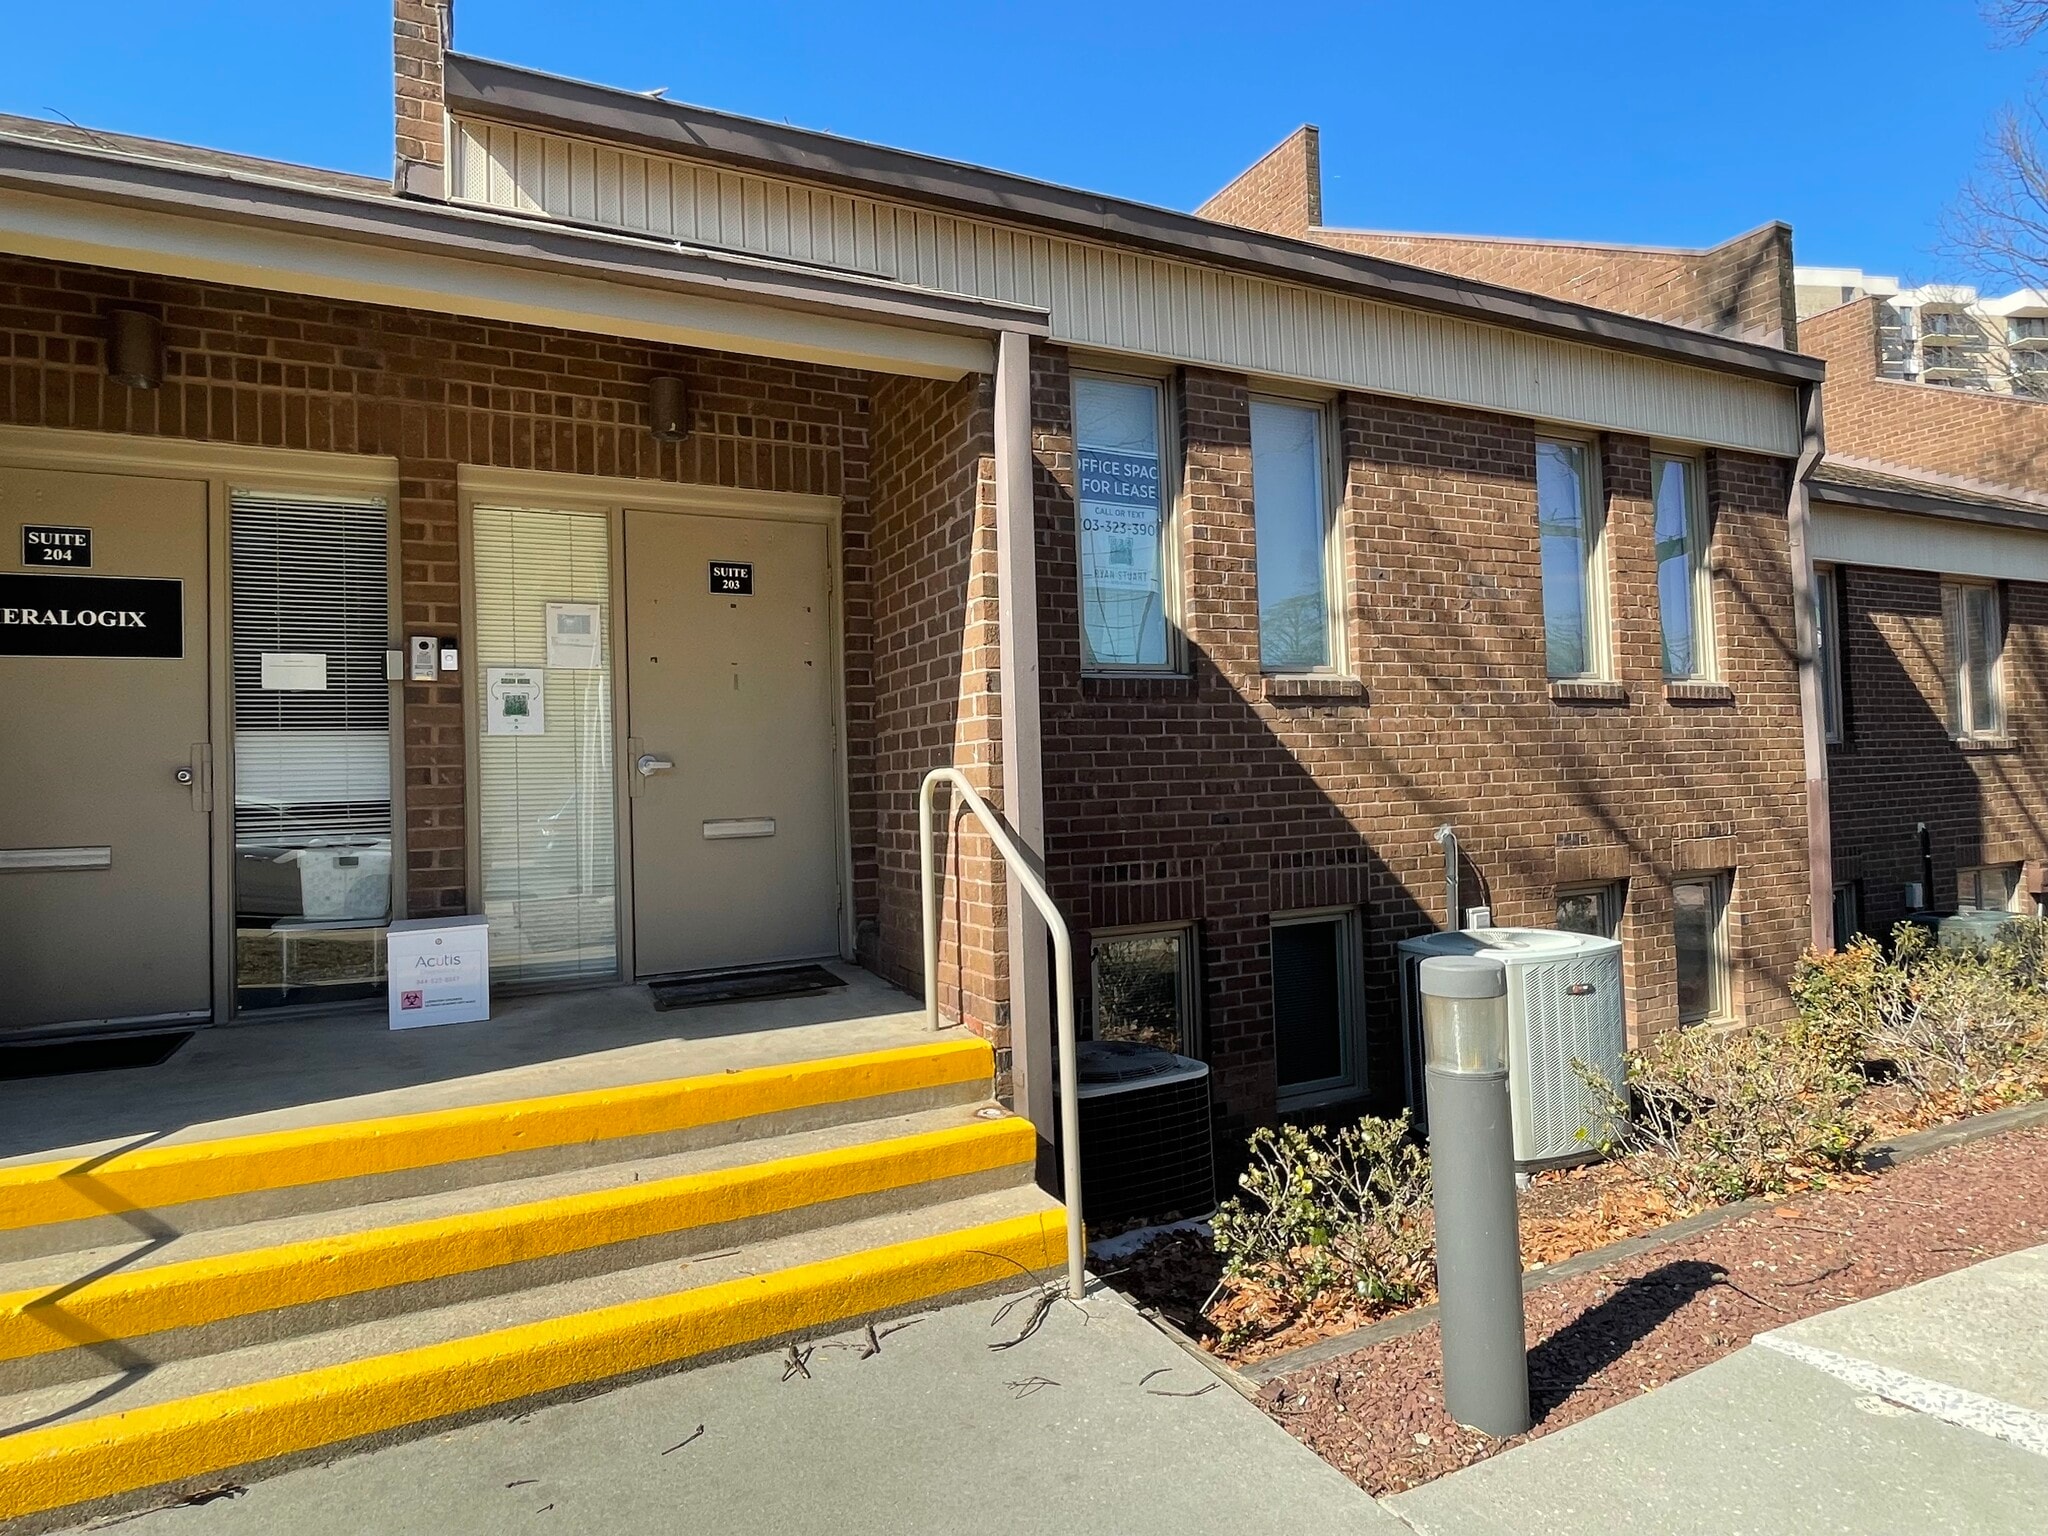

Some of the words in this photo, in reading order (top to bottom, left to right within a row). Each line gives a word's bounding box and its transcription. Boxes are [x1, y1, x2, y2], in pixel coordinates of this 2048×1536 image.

[1082, 478, 1111, 494] FOR
[1114, 481, 1156, 499] LEASE
[1095, 507, 1113, 516] CALL
[1115, 509, 1126, 518] OR
[1127, 510, 1145, 519] TEXT
[1081, 518, 1158, 537] 03-323-390
[28, 532, 86, 546] SUITE
[43, 549, 72, 561] 204
[713, 567, 749, 578] SUITE
[1095, 568, 1115, 579] RYAN
[1118, 571, 1147, 582] STUART
[722, 580, 741, 589] 203
[0, 608, 147, 628] ERALOGIX
[415, 954, 462, 968] Acutis
